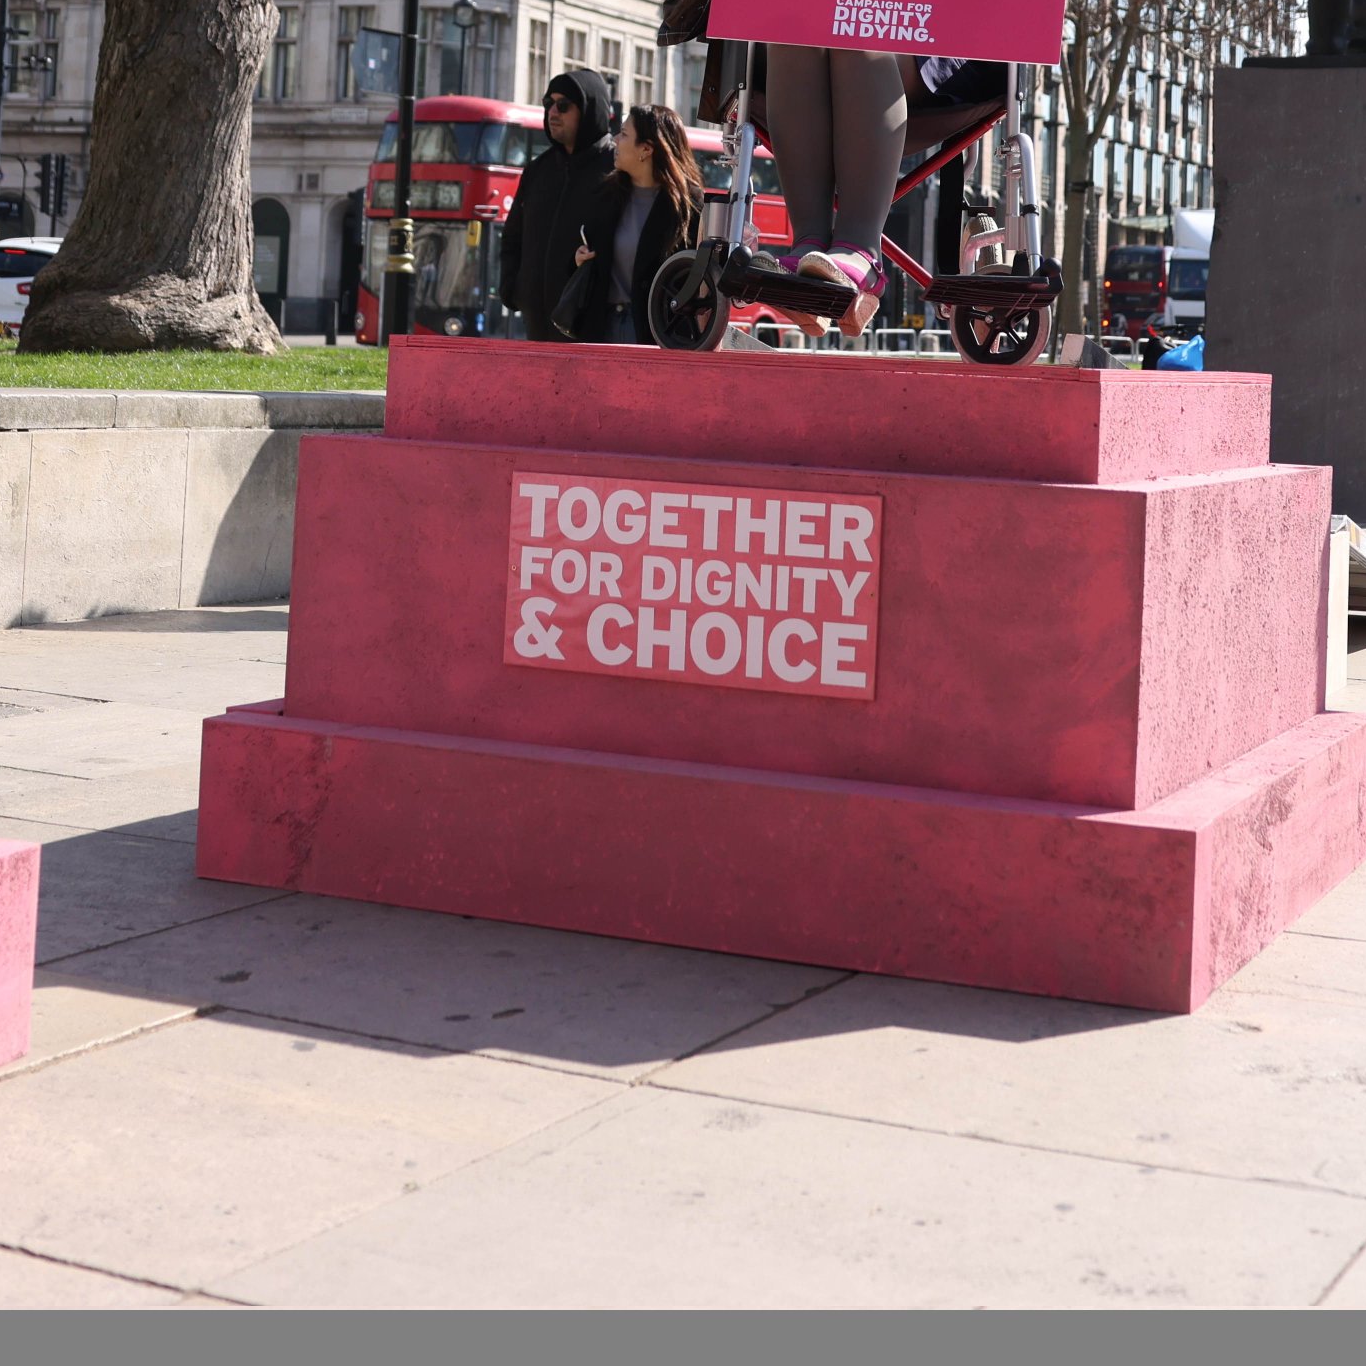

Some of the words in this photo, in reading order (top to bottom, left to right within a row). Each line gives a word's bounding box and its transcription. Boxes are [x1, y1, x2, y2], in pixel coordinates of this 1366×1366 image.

[834, 6, 931, 27] DIGNITY
[907, 2, 932, 13] FOR
[833, 21, 855, 36] IN
[859, 22, 934, 42] DYING.
[520, 483, 874, 562] TOGETHER
[520, 546, 622, 598] FOR
[641, 556, 870, 616] DIGNITY
[514, 597, 565, 660] &
[587, 603, 867, 688] CHOICE
